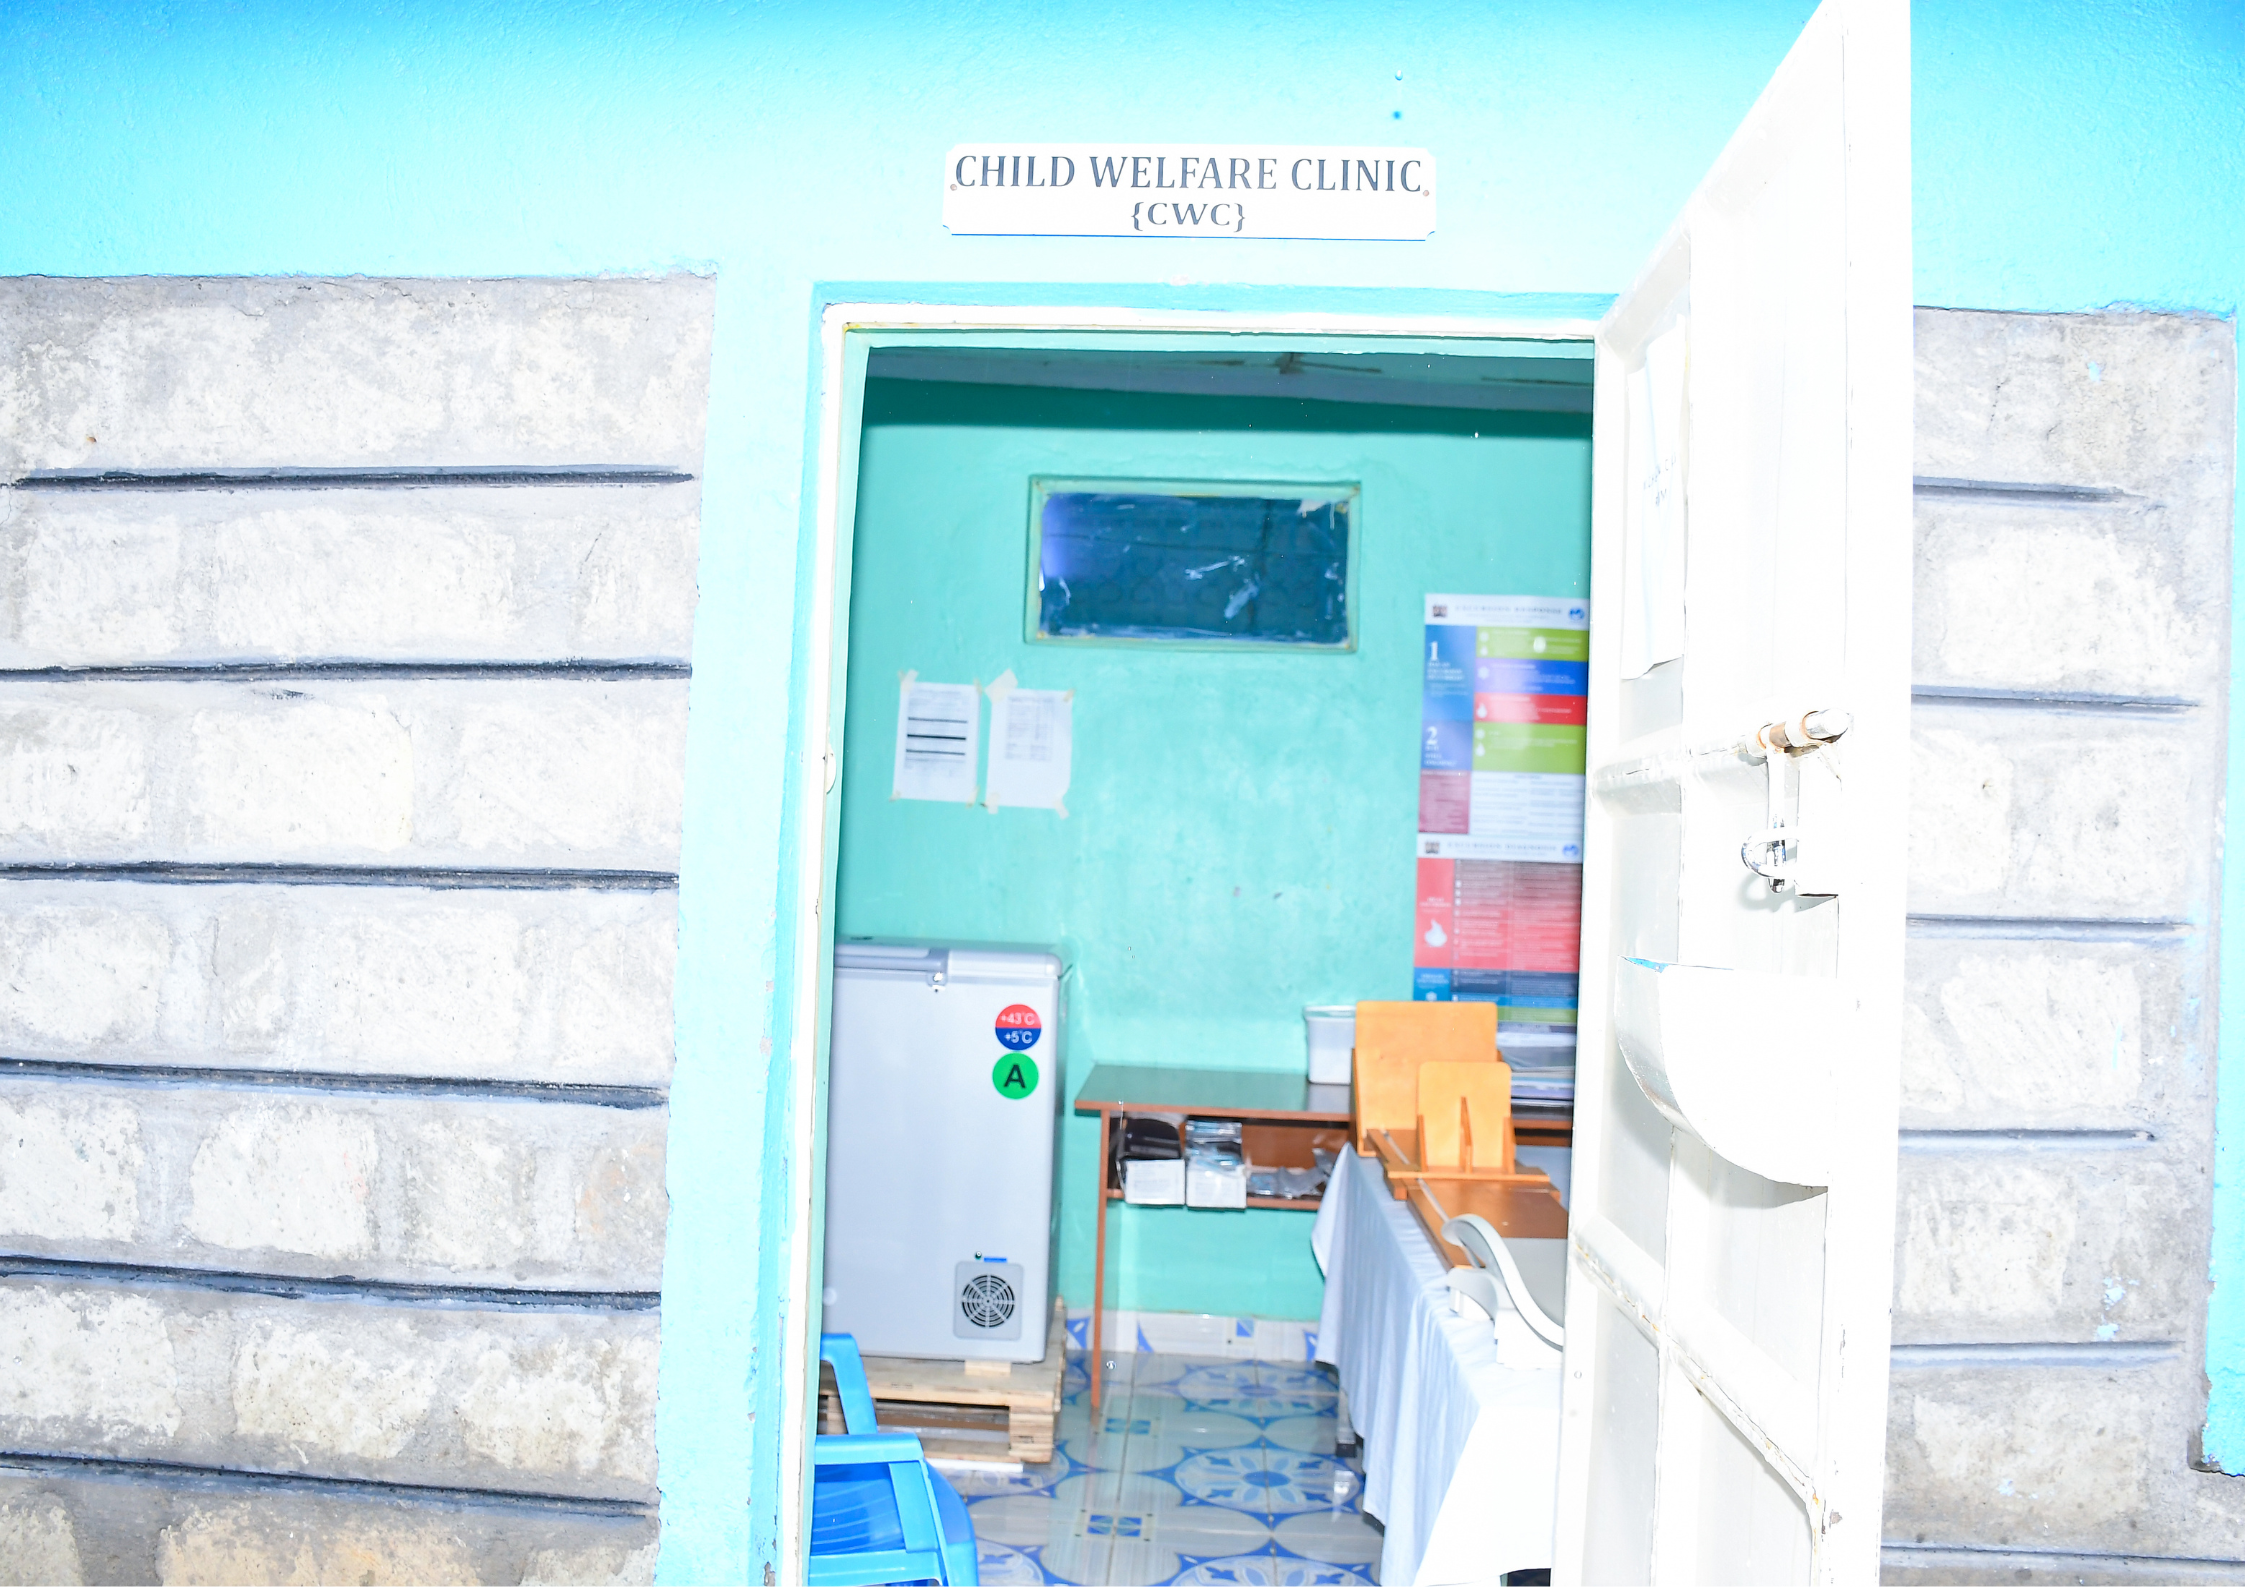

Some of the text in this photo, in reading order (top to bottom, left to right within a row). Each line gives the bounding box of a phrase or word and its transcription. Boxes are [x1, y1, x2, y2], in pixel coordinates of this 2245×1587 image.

[955, 154, 1422, 193] CHILD WELFARE CLINIC
[1131, 201, 1246, 232] {CWC}
[1429, 641, 1438, 661] 1
[1426, 726, 1438, 745] 2
[1003, 1064, 1026, 1089] A
